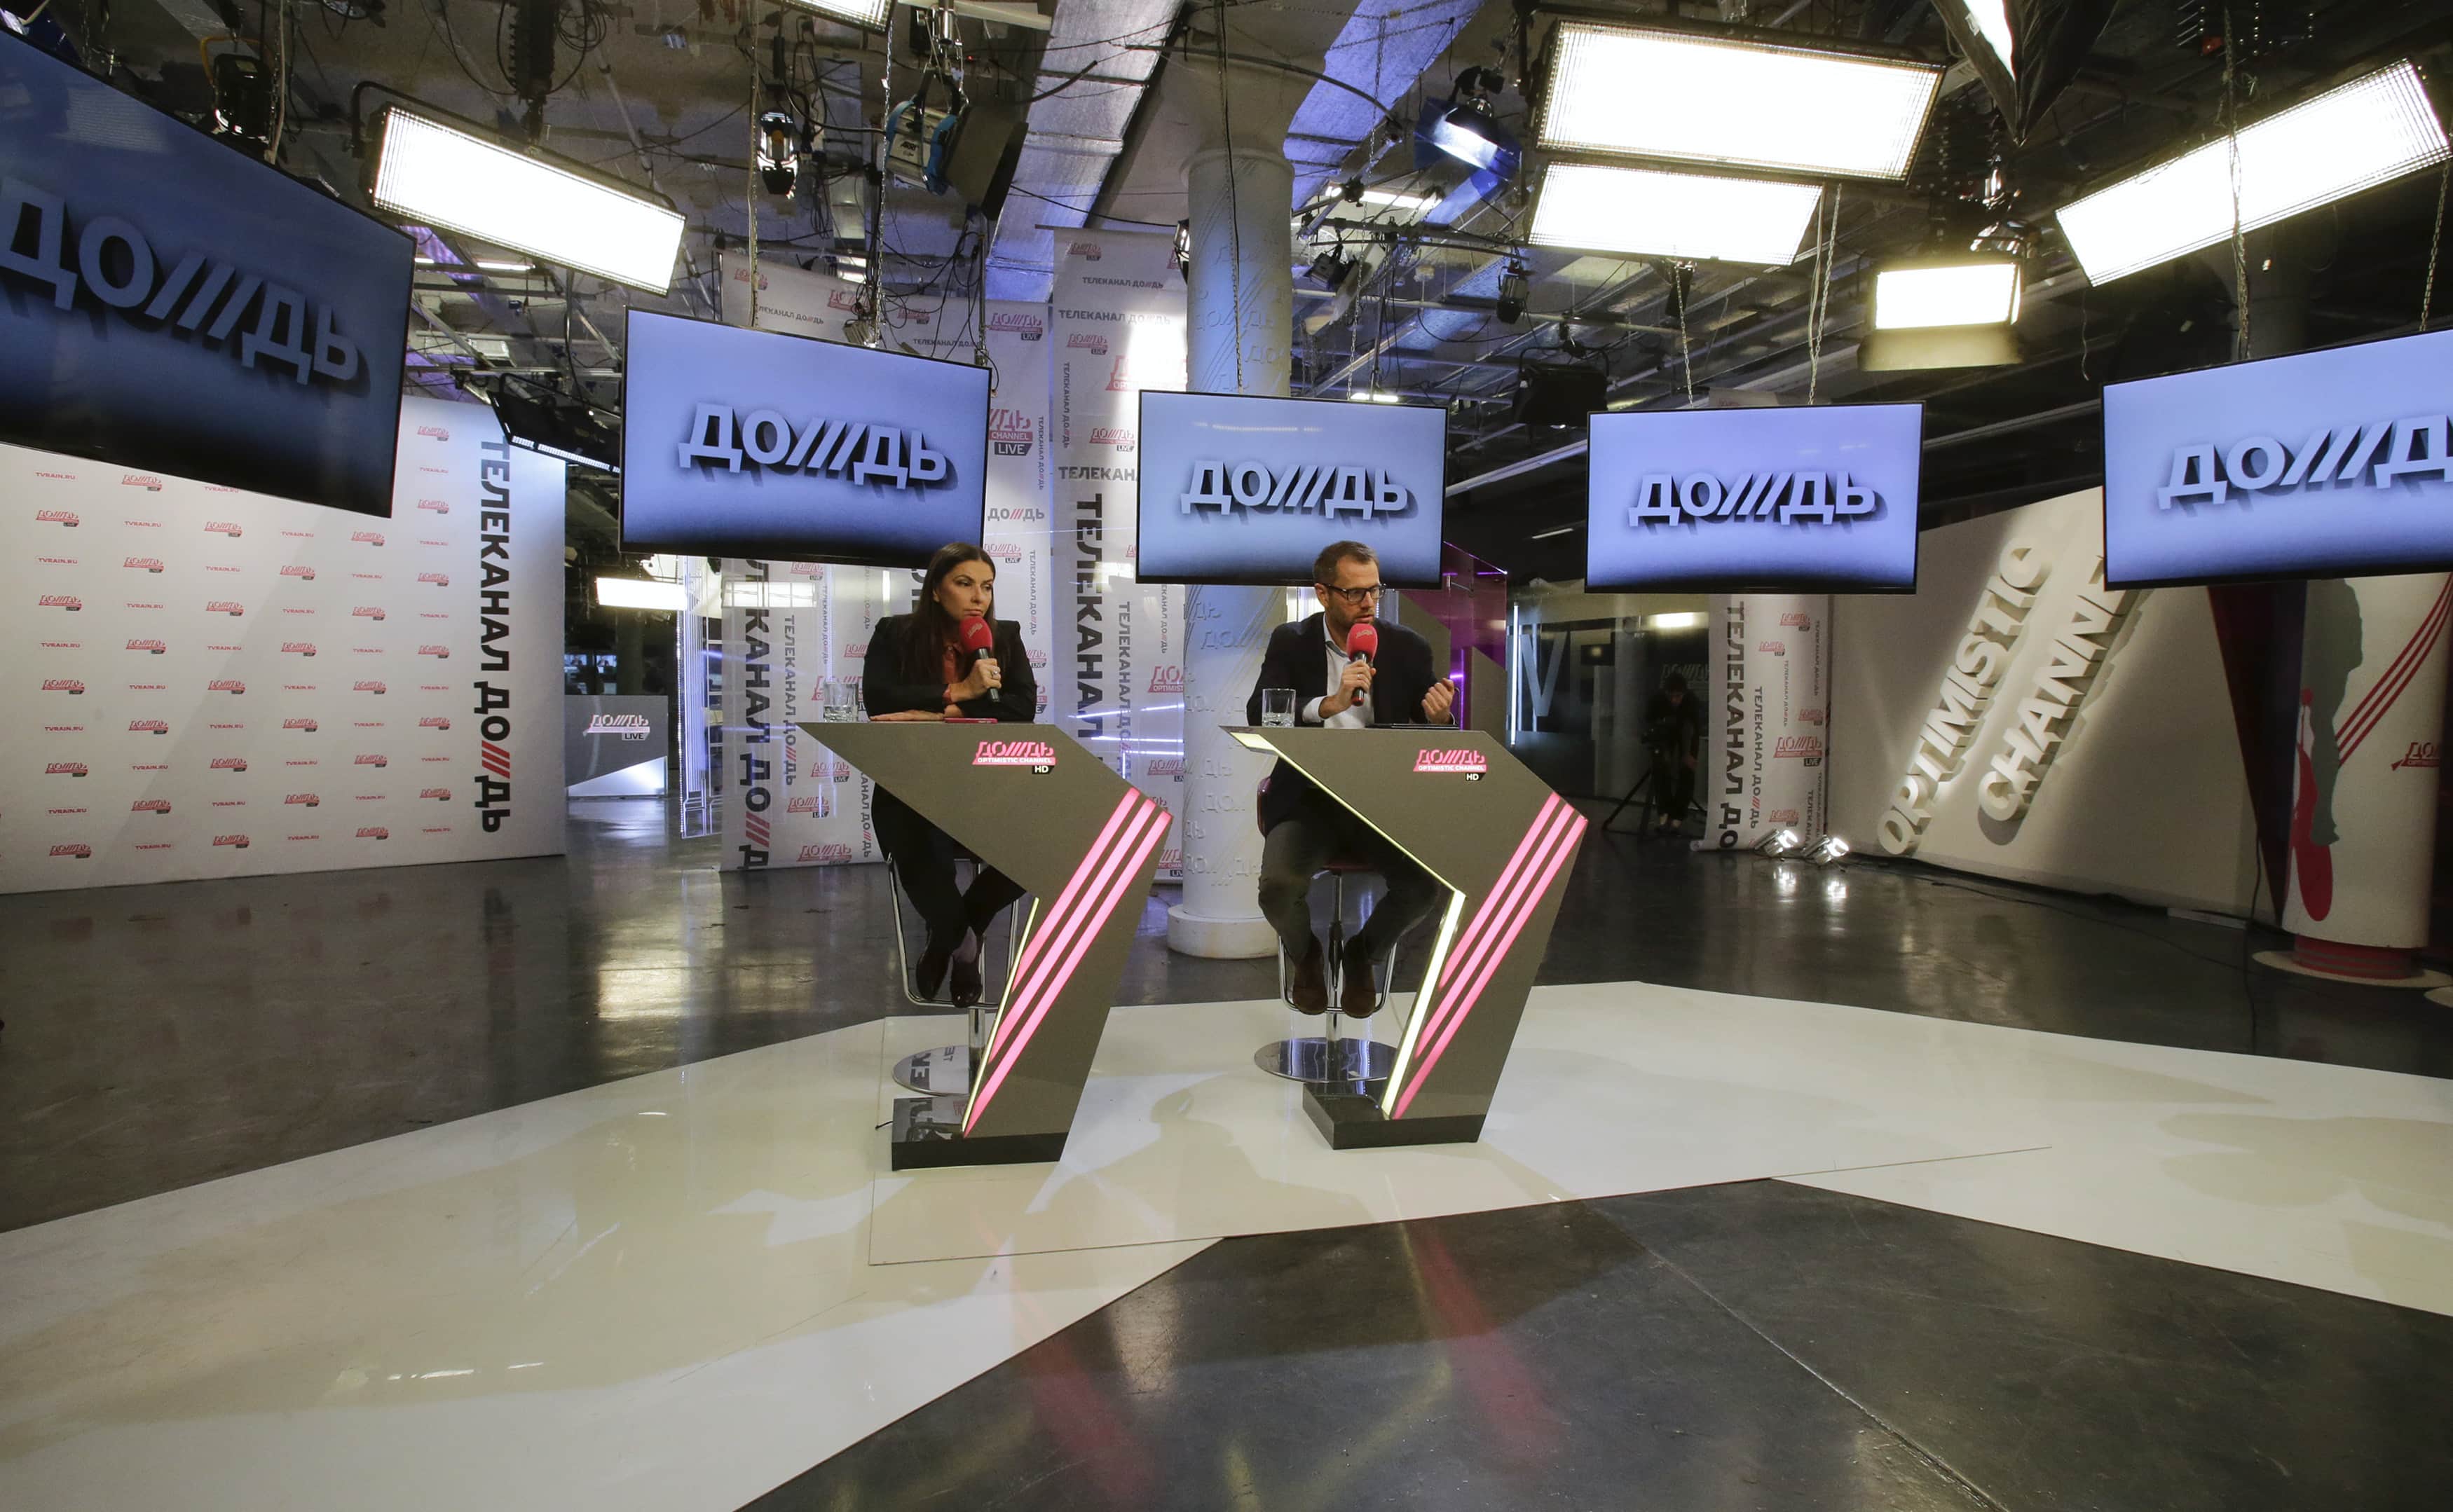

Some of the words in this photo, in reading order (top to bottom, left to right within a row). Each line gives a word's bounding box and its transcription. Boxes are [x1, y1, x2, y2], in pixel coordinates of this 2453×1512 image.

[1058, 310, 1126, 322] ТЕЛЕКАНАЛ
[1082, 277, 1131, 287] ТЕЛЕКАНАЛ
[36, 471, 76, 480] TVRAIN.RU
[999, 444, 1025, 455] LIVE
[1058, 466, 1137, 481] ТЕЛЕКАН
[481, 436, 510, 671] ТЕЛЕКАНАЛ
[1077, 493, 1103, 738] ТЕЛЕКАНАЛ
[1119, 601, 1131, 712] ТЕЛЕКАНАЛ
[784, 615, 796, 719] ТЕЛЕКАНАЛ
[1726, 601, 1744, 795] ТЕЛЕКАНАЛ
[1878, 538, 2041, 854] OPTIMISTIC
[1754, 686, 1763, 771] ТЕЛЕКАНАЛ
